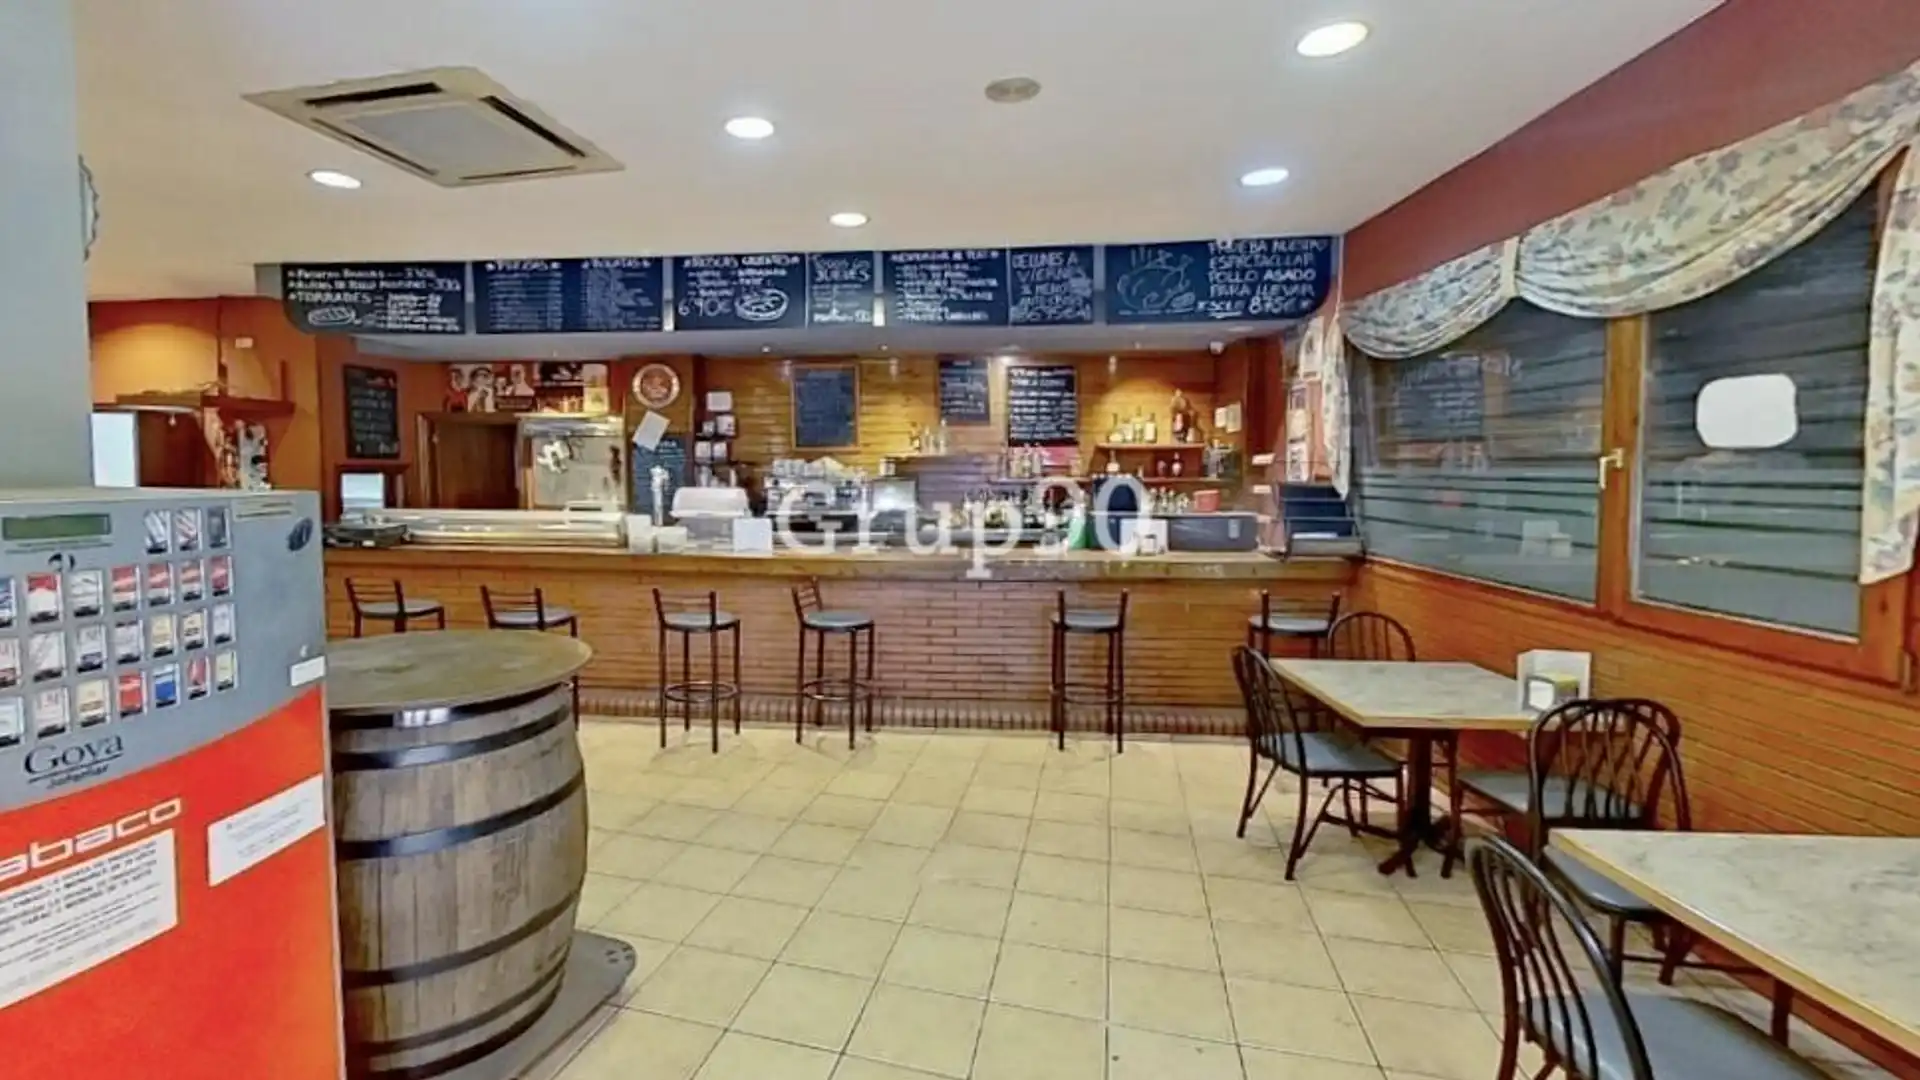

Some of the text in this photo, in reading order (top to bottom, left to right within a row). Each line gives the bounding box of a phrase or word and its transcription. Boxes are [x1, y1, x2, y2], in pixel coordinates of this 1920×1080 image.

[1208, 269, 1316, 284] POLLO ASADO
[1209, 284, 1250, 298] PARA
[24, 734, 125, 776] Goya
